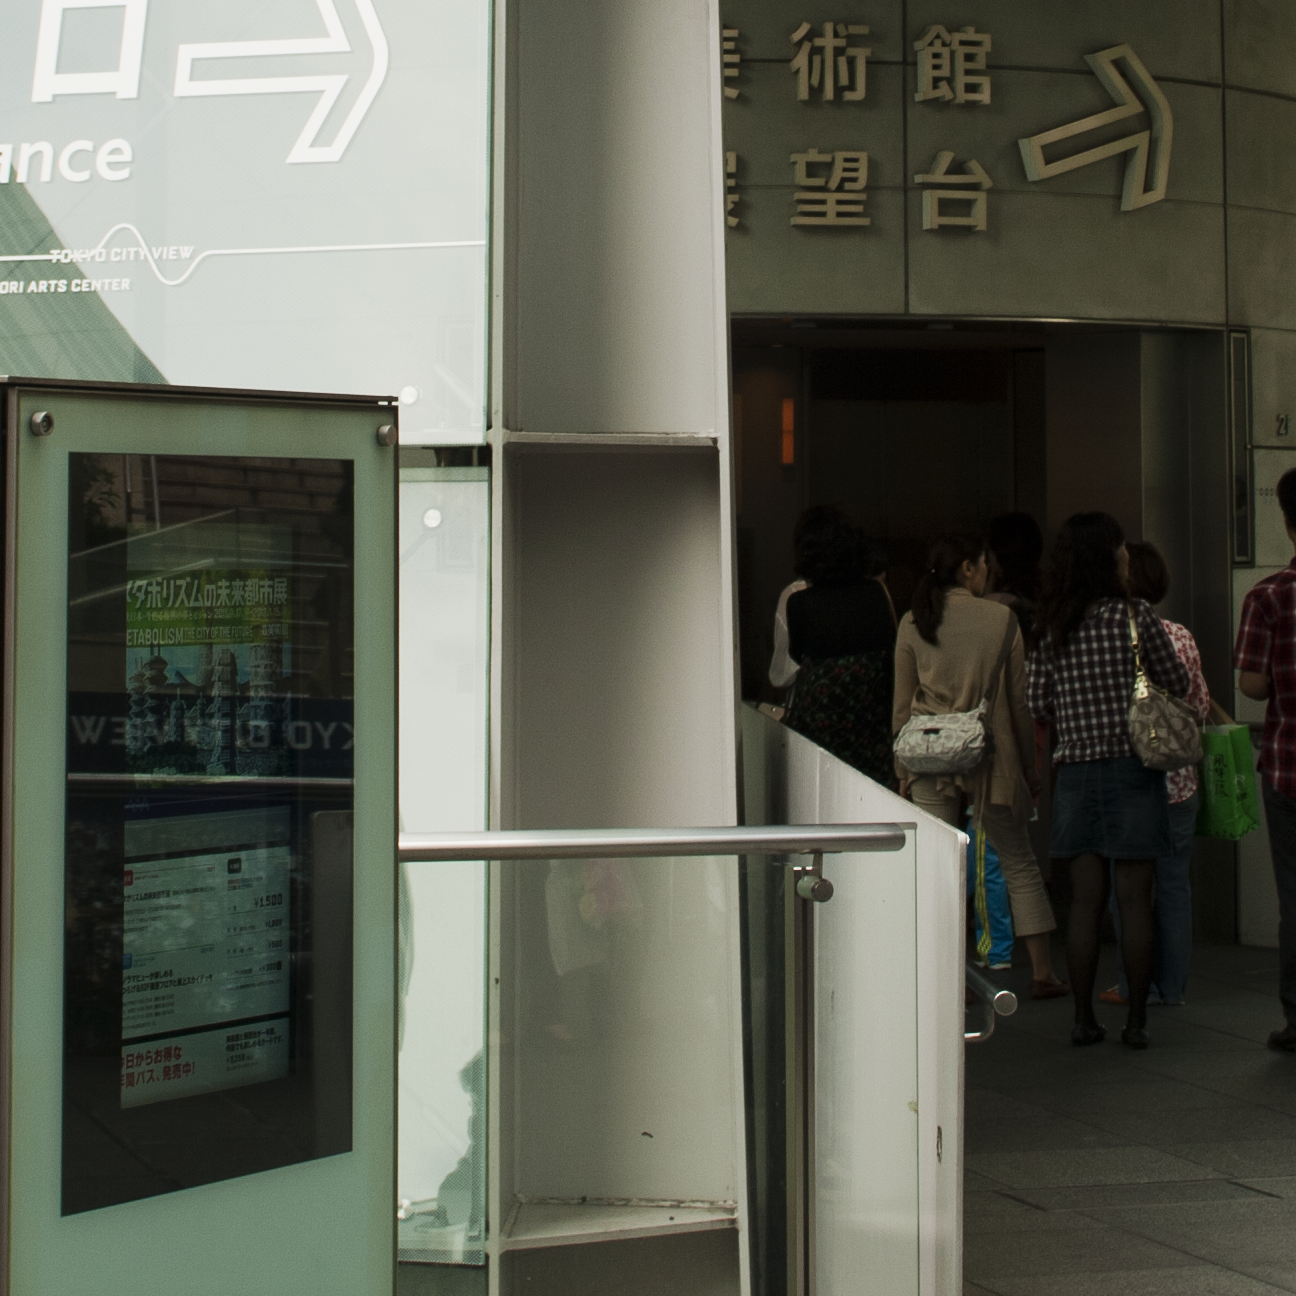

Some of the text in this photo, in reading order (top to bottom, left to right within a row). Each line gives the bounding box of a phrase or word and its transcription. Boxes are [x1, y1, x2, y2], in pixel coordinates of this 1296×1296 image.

[723, 21, 992, 105] 術館
[725, 148, 993, 232] 望台
[49, 245, 194, 263] TOKYO CITY VIEW
[26, 279, 68, 293] ARTS
[70, 278, 131, 292] CENTER
